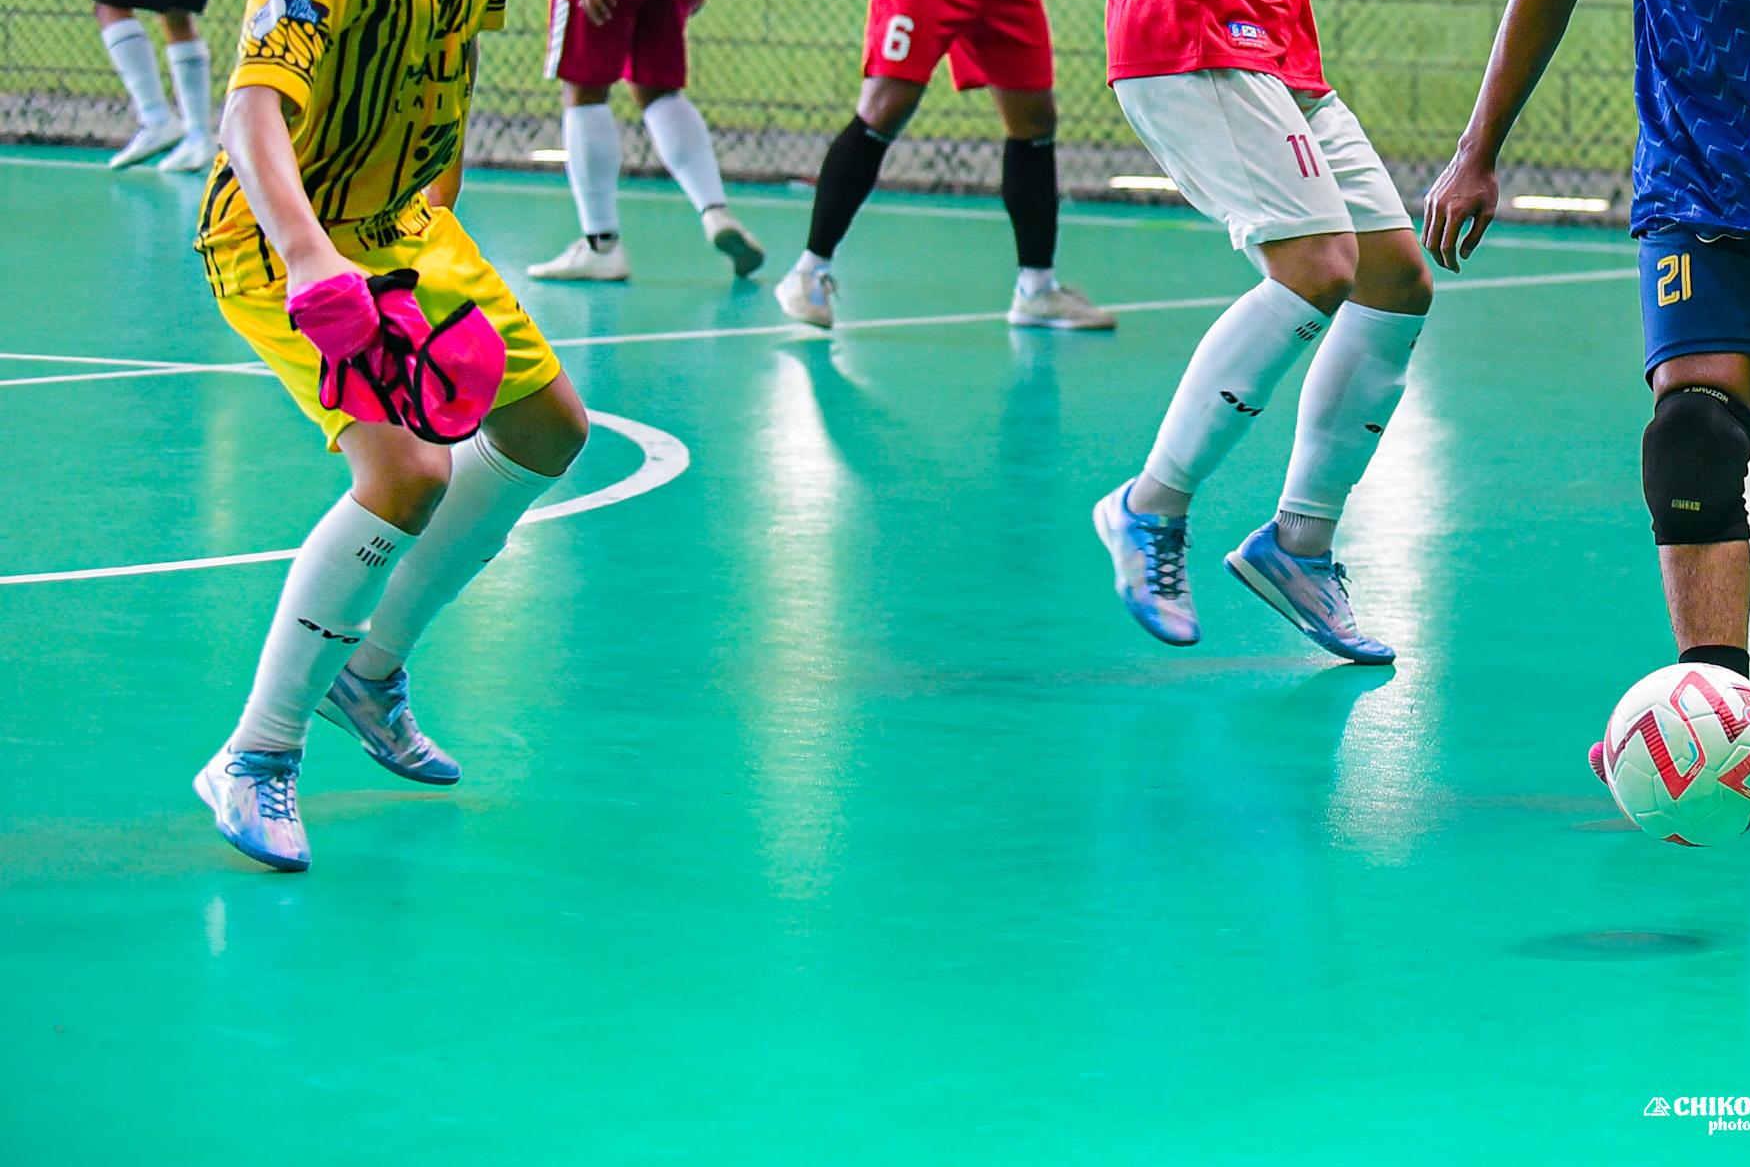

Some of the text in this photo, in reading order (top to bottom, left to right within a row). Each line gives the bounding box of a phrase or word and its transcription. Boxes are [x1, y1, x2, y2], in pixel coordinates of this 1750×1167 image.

[881, 14, 914, 61] 6
[1286, 134, 1320, 177] 11
[1657, 253, 1693, 307] 21
